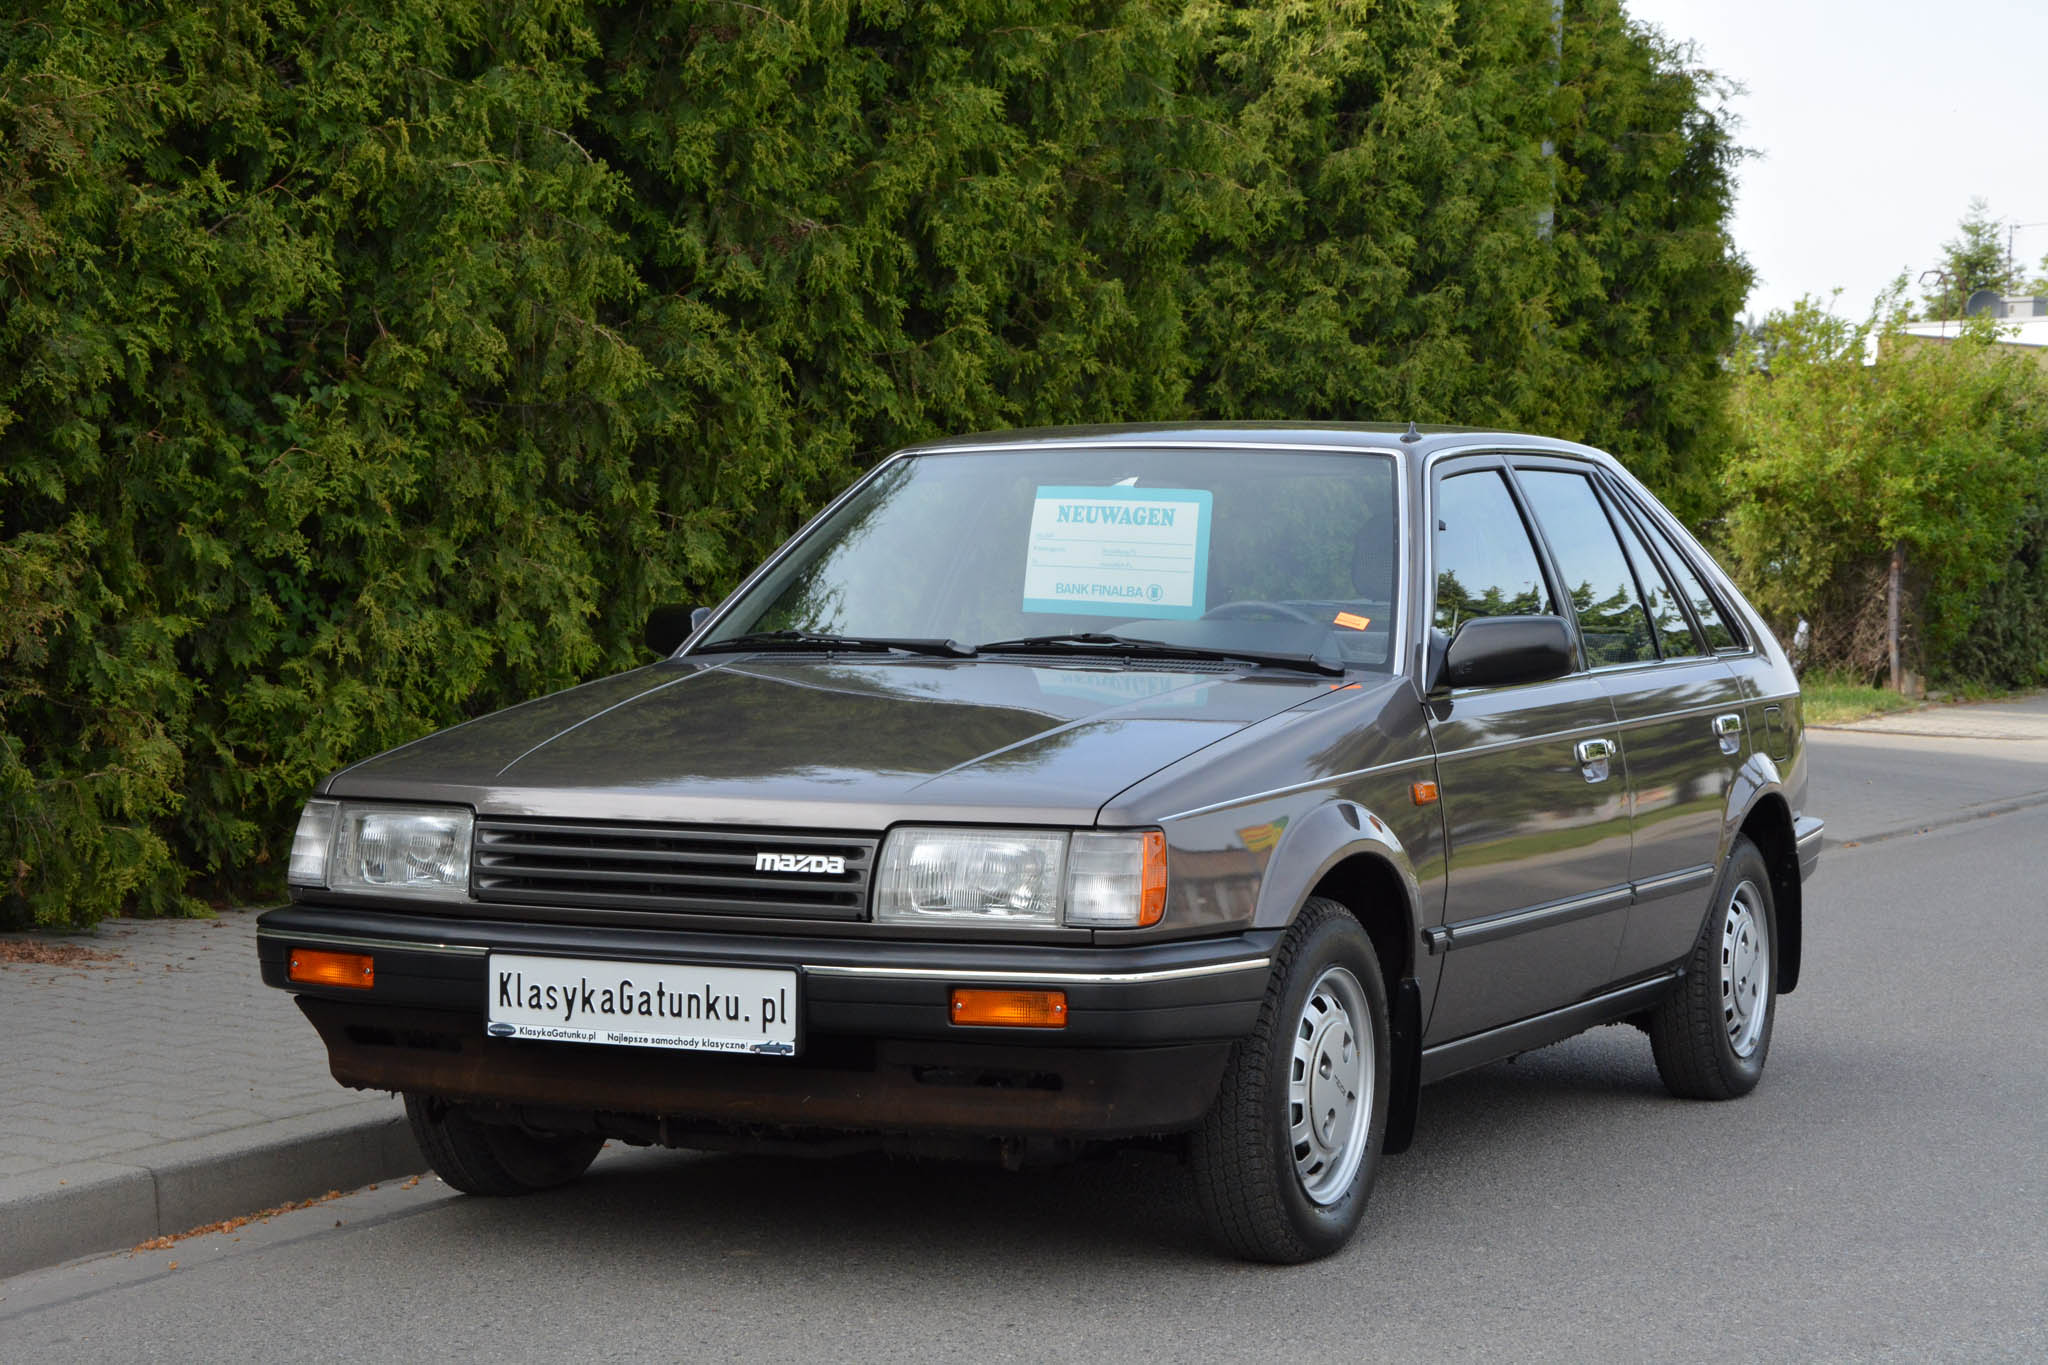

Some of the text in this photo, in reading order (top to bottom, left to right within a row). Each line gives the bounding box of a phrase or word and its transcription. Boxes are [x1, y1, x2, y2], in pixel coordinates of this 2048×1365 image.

[1057, 505, 1176, 527] NEUWAGEN
[1055, 582, 1144, 599] BANK FINALBA
[519, 1026, 597, 1041] KlasykaGatunku.pl
[607, 1033, 648, 1045] Najlepsze
[651, 1036, 699, 1048] samochody
